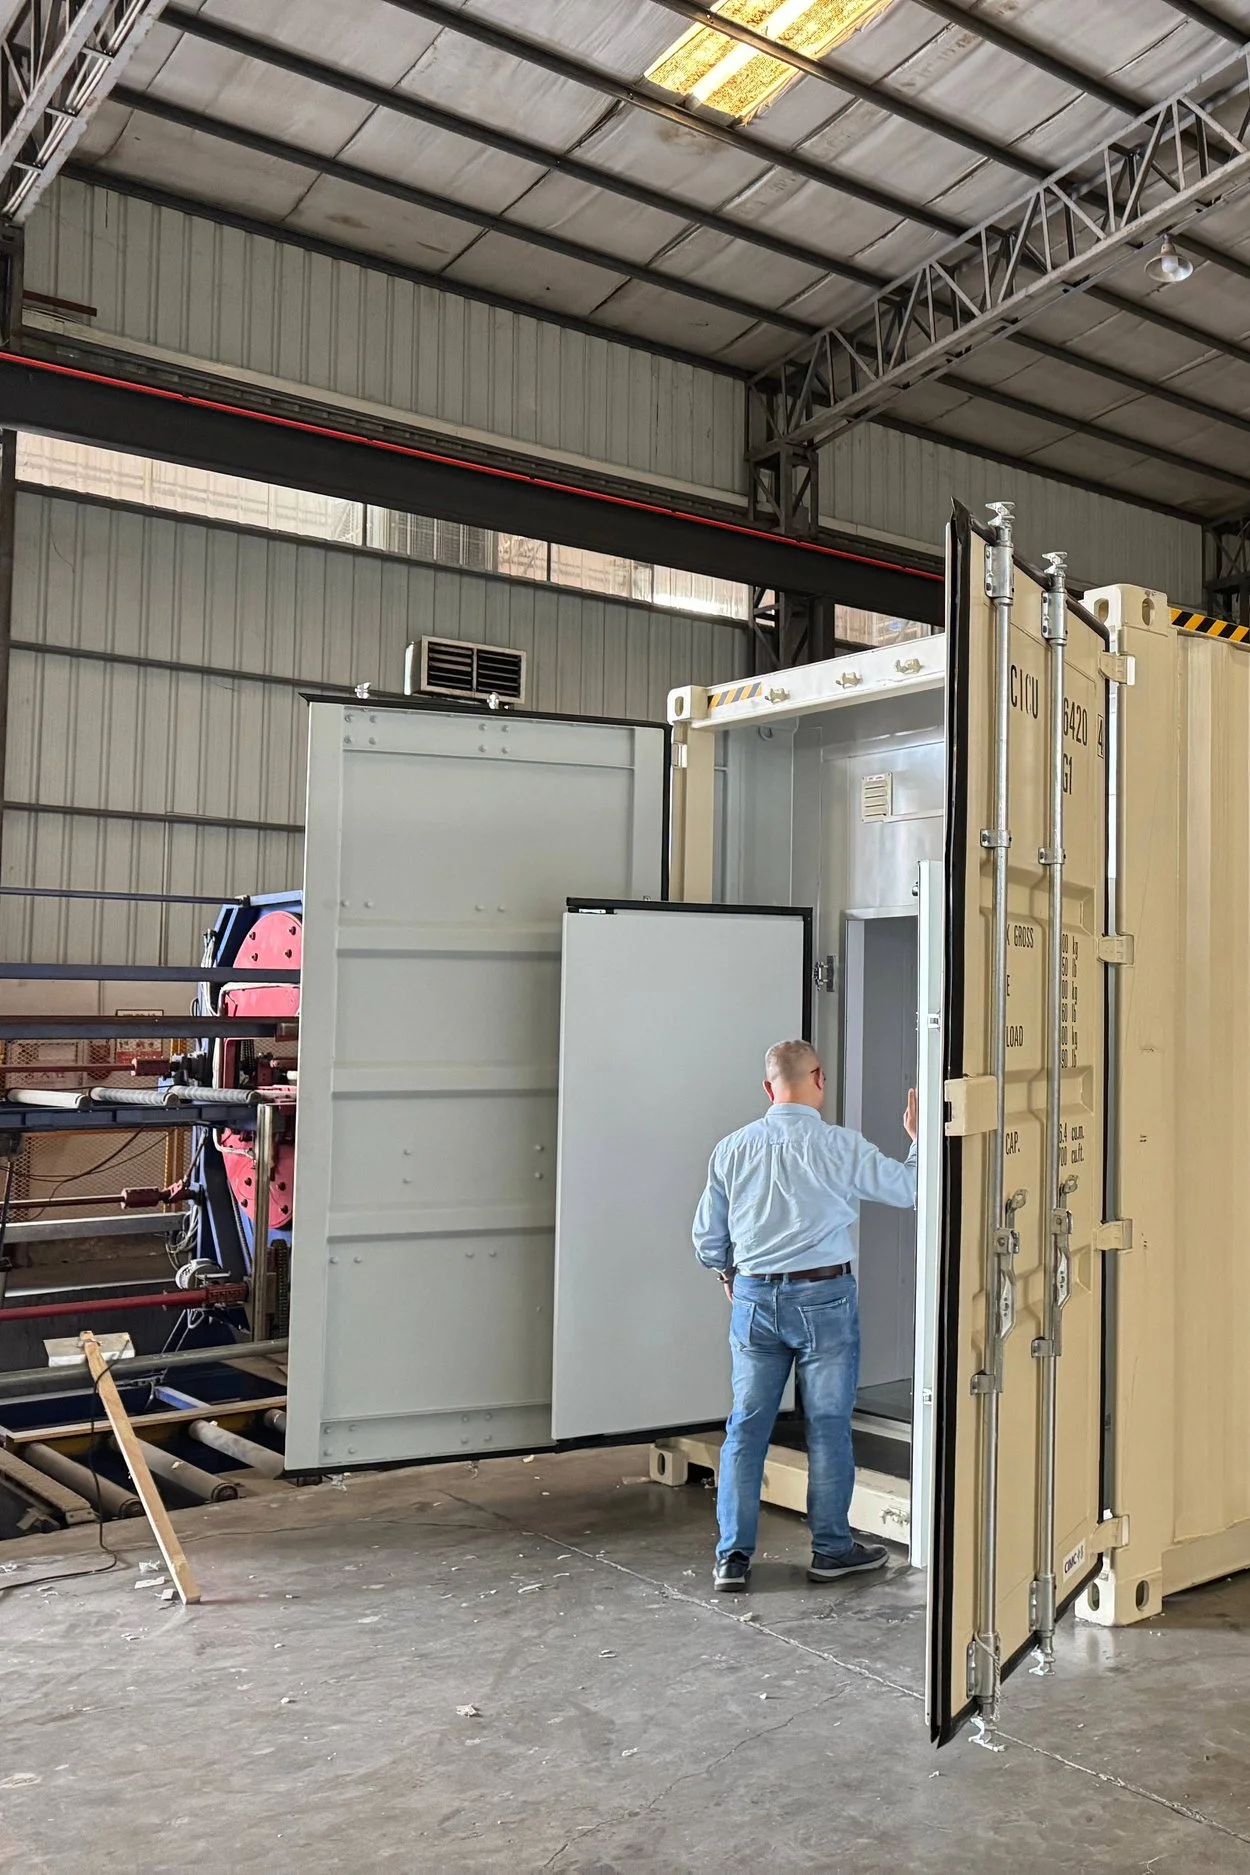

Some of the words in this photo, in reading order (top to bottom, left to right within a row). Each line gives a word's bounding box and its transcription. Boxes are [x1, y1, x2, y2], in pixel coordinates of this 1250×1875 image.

[1063, 697, 1088, 746] 6420
[1062, 753, 1073, 795] G1
[1013, 925, 1034, 949] GROSS
[1006, 1025, 1024, 1048] LOAD
[1005, 1131, 1021, 1156] CAP.
